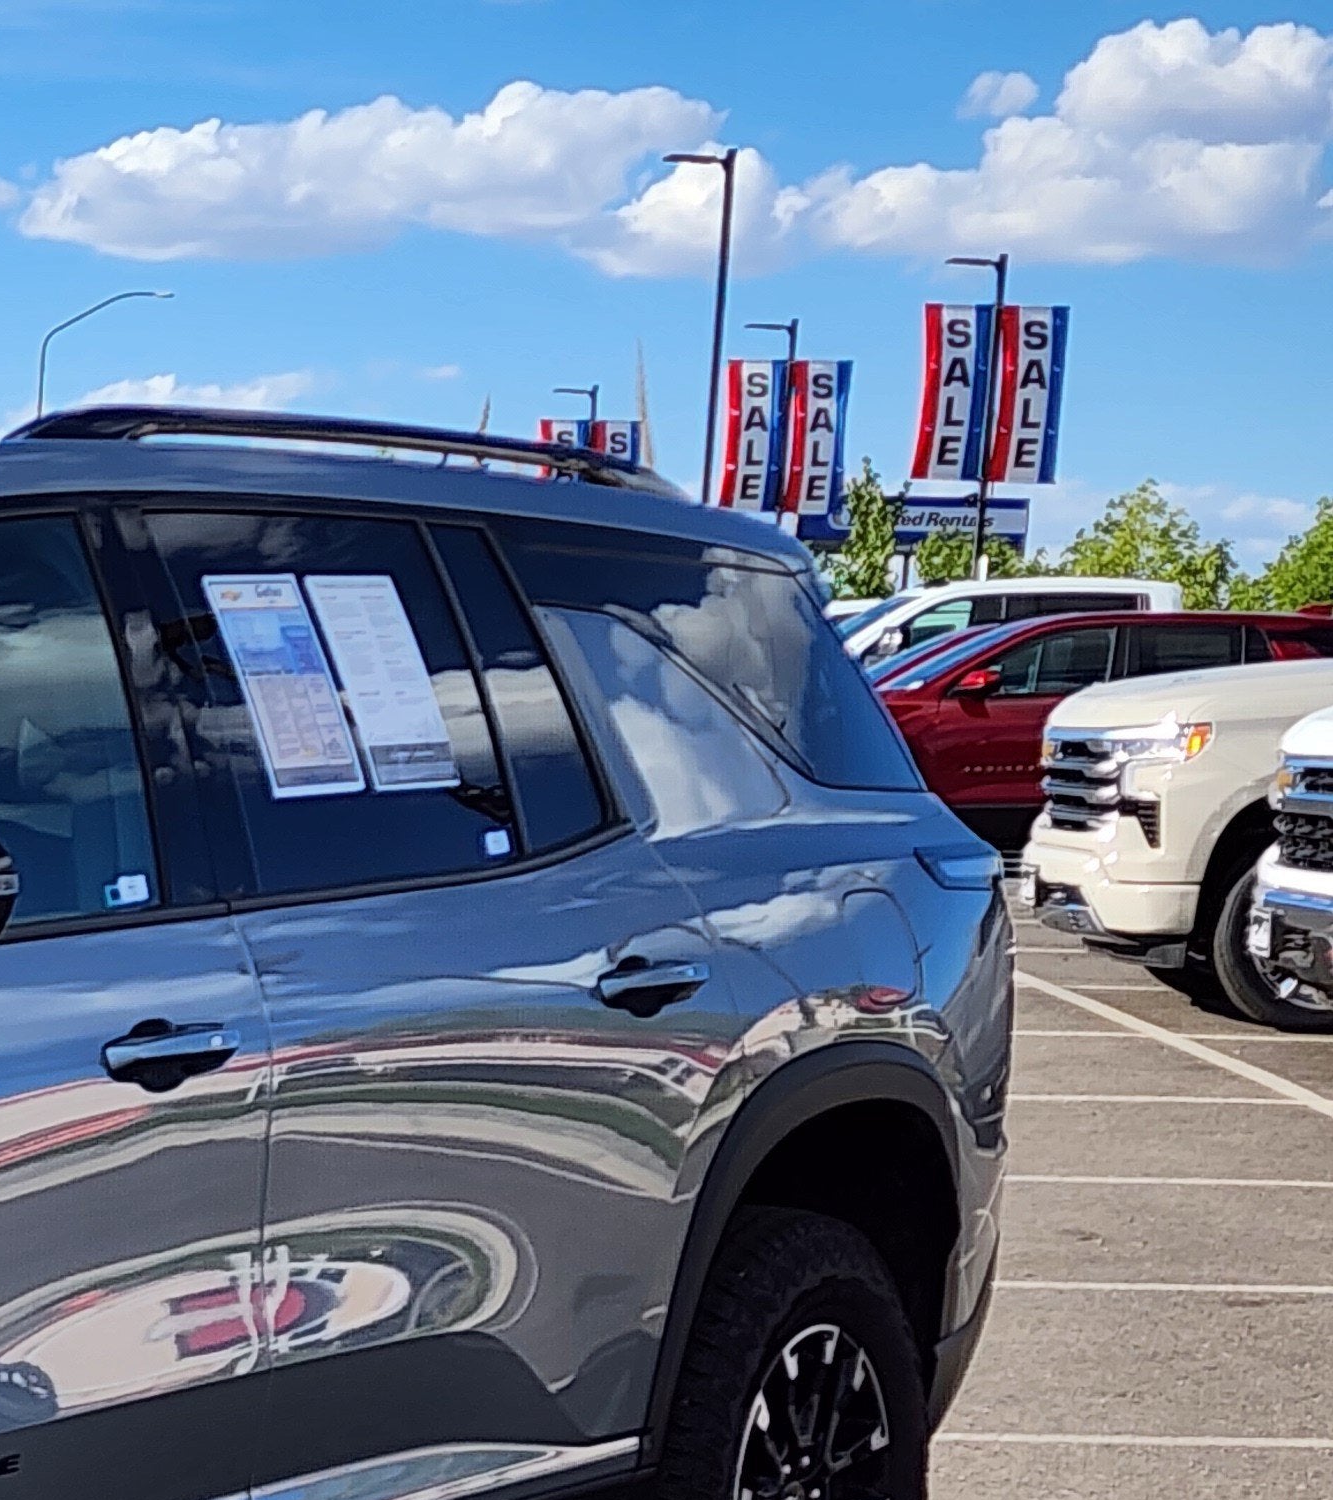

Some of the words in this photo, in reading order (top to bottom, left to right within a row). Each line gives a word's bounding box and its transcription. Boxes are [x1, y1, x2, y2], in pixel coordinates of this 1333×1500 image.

[739, 372, 769, 500] SALE
[805, 373, 834, 501] SALE
[937, 319, 972, 466] SALE
[1014, 320, 1048, 468] SALE
[926, 512, 995, 528] Rentas
